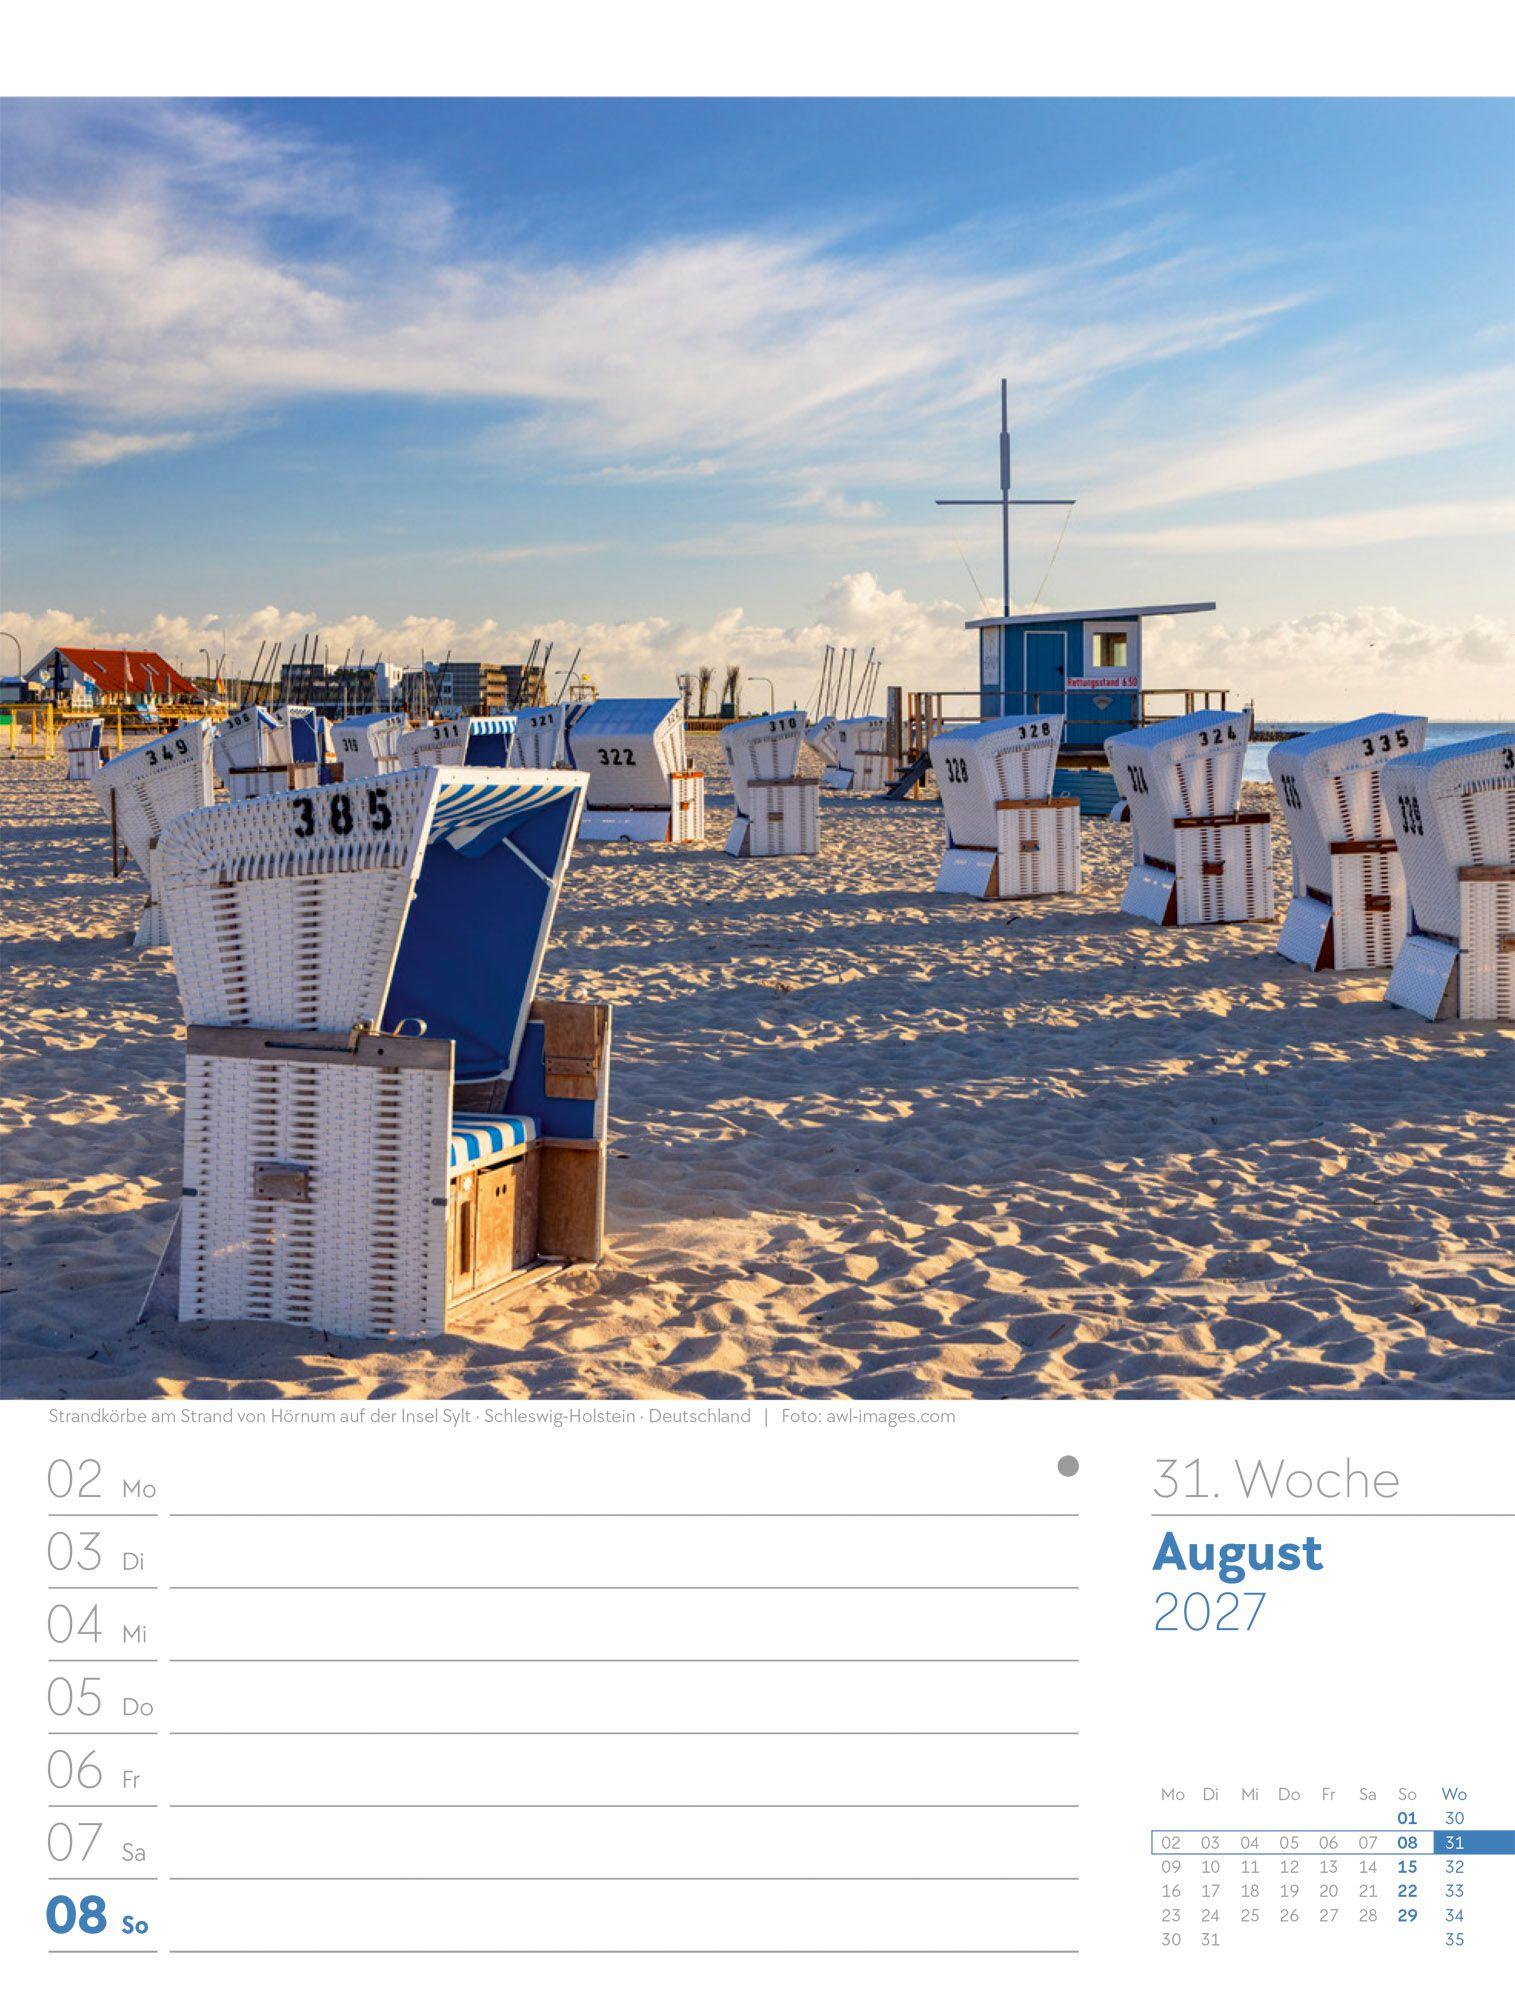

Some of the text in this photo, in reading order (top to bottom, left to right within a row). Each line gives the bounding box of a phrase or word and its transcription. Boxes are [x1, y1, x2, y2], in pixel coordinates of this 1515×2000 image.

[1067, 677, 1120, 689] Rettungsstand
[433, 724, 459, 740] 311
[530, 713, 554, 727] 321
[769, 716, 797, 732] 310
[1018, 722, 1051, 740] 328
[1199, 724, 1237, 747] 324
[1362, 728, 1409, 757] 335
[145, 738, 188, 766] 349
[598, 748, 636, 766] 322
[945, 757, 969, 783] 328
[293, 787, 392, 838] 385
[48, 1459, 156, 1498] 02 Mo
[1154, 1457, 1399, 1498] 31. Woche
[48, 1532, 143, 1570] 03 Di
[1152, 1530, 1326, 1584] August
[48, 1604, 146, 1643] 04 Mi
[1152, 1592, 1267, 1632] 2027
[48, 1677, 153, 1716] 05 Do
[48, 1750, 140, 1789] 06 Fr
[1162, 1787, 1467, 1800] Mo Di Mi Do Fr Sa So Wo
[1397, 1811, 1464, 1825] 01 30
[48, 1822, 145, 1861] 07 Sa
[1162, 1835, 1464, 1850] 02 03 04 05 06 07 08 31
[1162, 1859, 1464, 1873] 09 10 11 12 13 14 15 32
[1163, 1883, 1464, 1898] 16 17 18 19 20 21 22 33
[46, 1895, 148, 1936] 08 So
[1162, 1907, 1464, 1922] 23 24 25 26 27 28 29 34
[1162, 1932, 1464, 1946] 30 31 35
